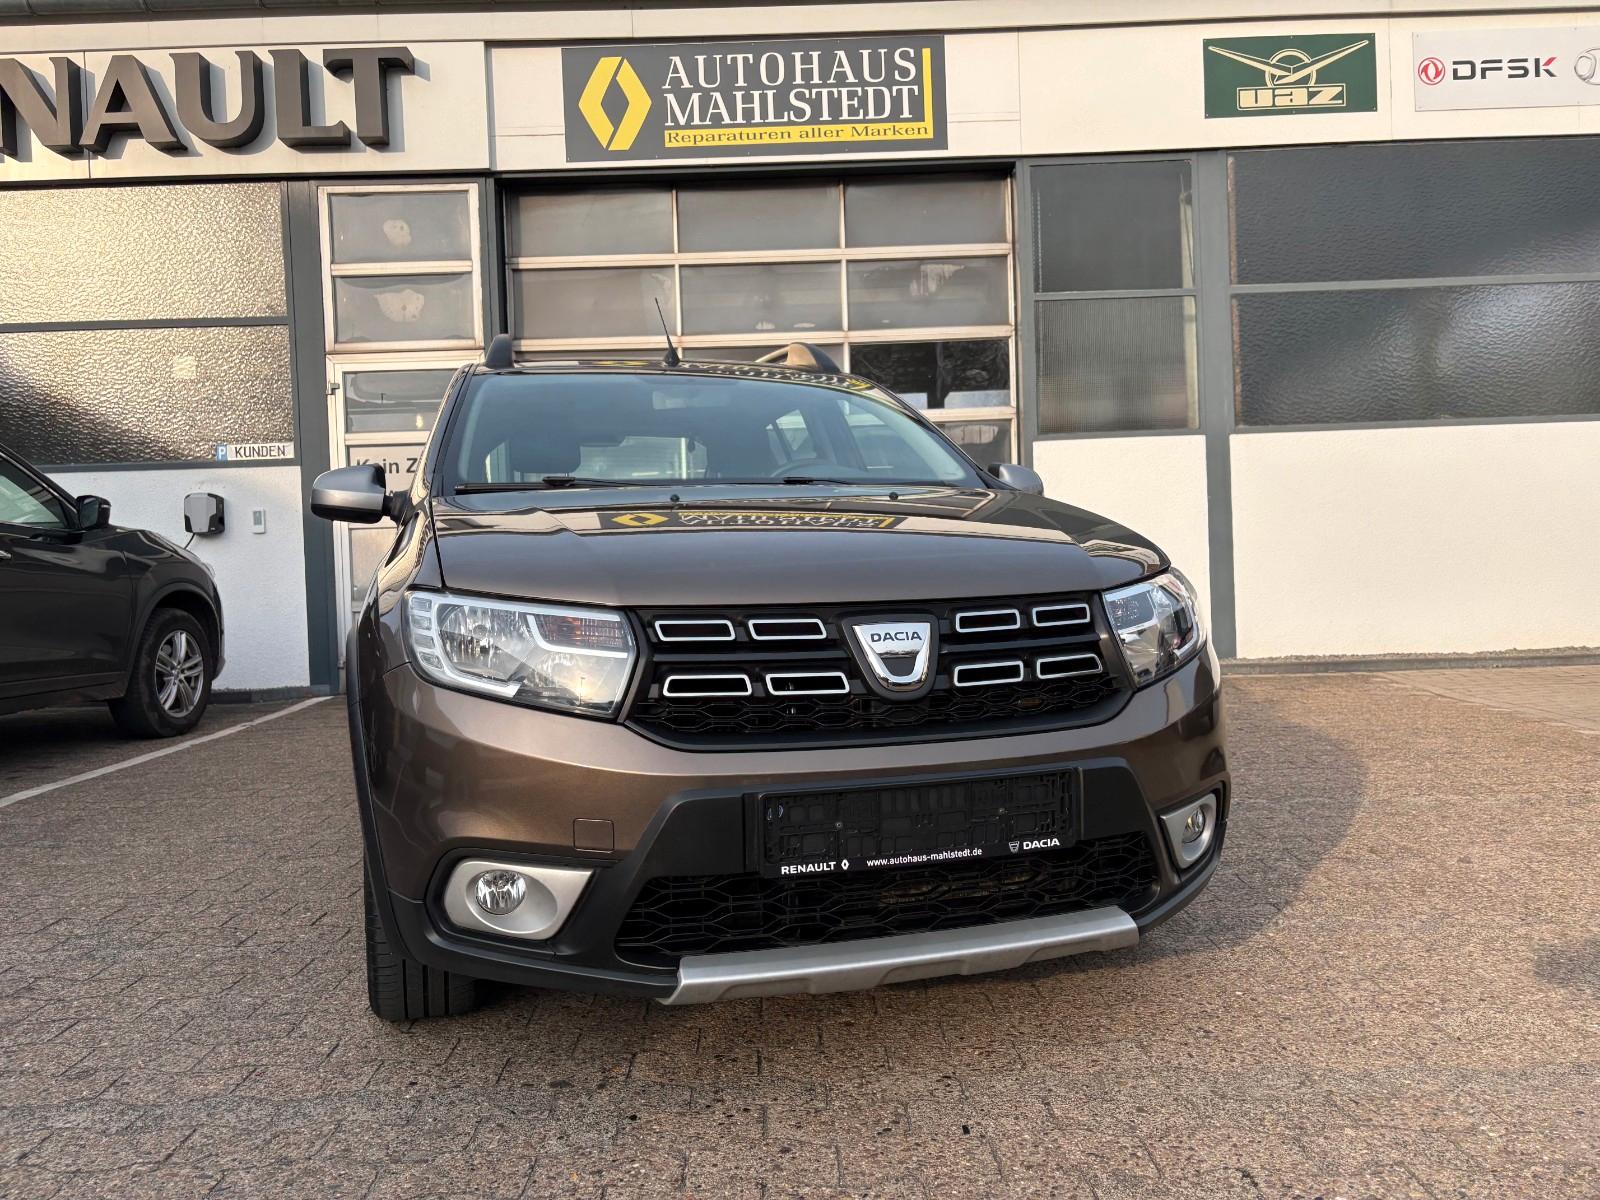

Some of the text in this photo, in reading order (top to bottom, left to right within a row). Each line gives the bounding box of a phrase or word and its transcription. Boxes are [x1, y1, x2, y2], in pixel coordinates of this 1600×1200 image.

[661, 47, 917, 88] AUTOHAUS
[1452, 56, 1558, 81] DFSK
[663, 85, 919, 126] MAHLSTEDT
[667, 124, 929, 145] Reparaturen aller Marken
[234, 445, 287, 458] KUNDEN
[870, 631, 923, 643] DACIA
[780, 838, 1061, 875] RENAULT www.autohaus-mahlstedt.de DACIA
